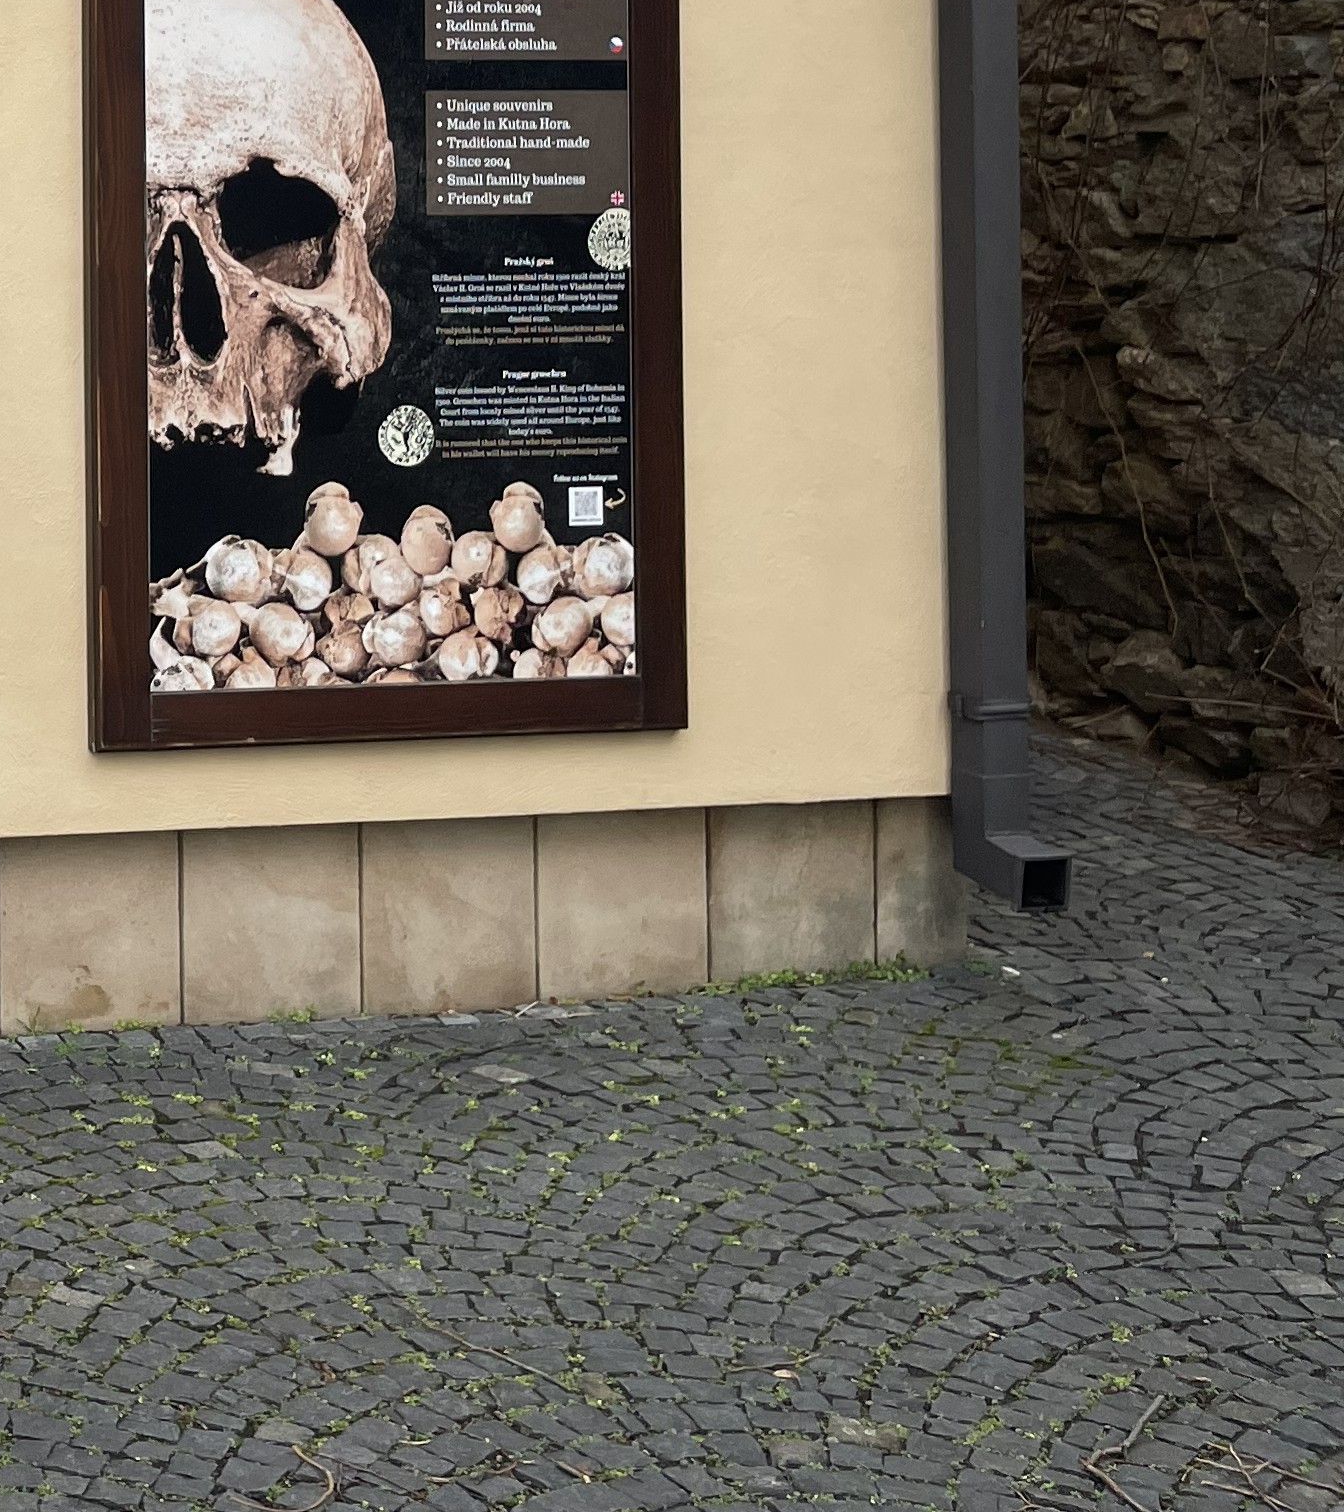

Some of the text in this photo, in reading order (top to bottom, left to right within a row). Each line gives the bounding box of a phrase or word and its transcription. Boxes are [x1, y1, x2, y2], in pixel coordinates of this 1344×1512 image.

[446, 1, 541, 16] Již od roku 2004
[446, 20, 534, 32] Rodinná firma
[446, 38, 556, 51] Přátelská obsluha
[447, 100, 552, 114] Unique souvenirs
[447, 118, 570, 130] Made in Kutna Hora
[447, 137, 589, 149] Traditional hand-made
[447, 155, 510, 169] Since 2004
[448, 174, 585, 187] Small familly business
[448, 192, 533, 207] Friendly staff
